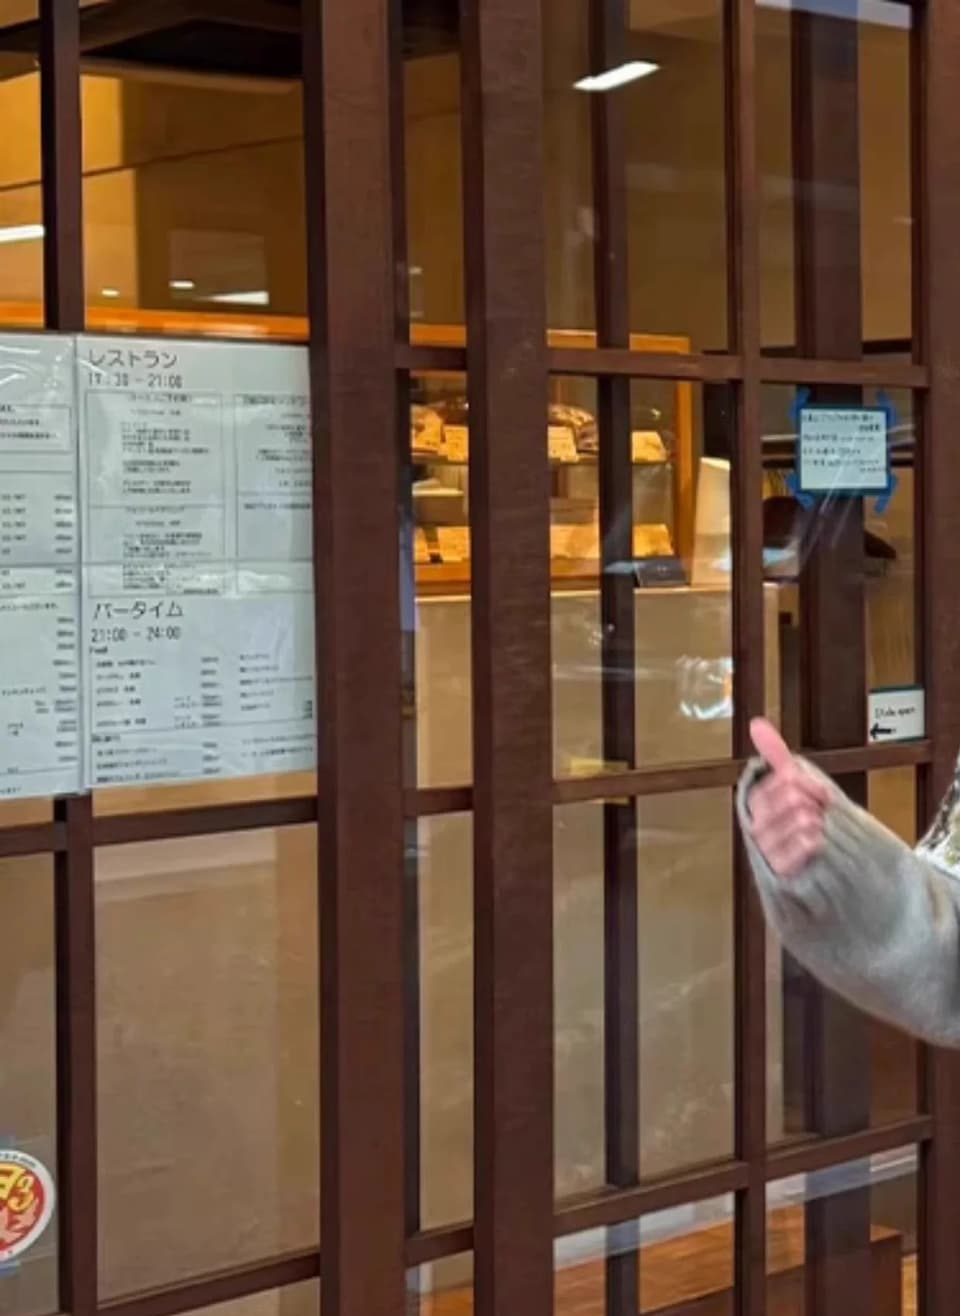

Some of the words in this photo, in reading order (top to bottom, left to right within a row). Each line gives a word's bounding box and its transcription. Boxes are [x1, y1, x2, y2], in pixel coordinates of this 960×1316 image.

[88, 349, 178, 369] レストラン
[91, 627, 127, 642] 21:00
